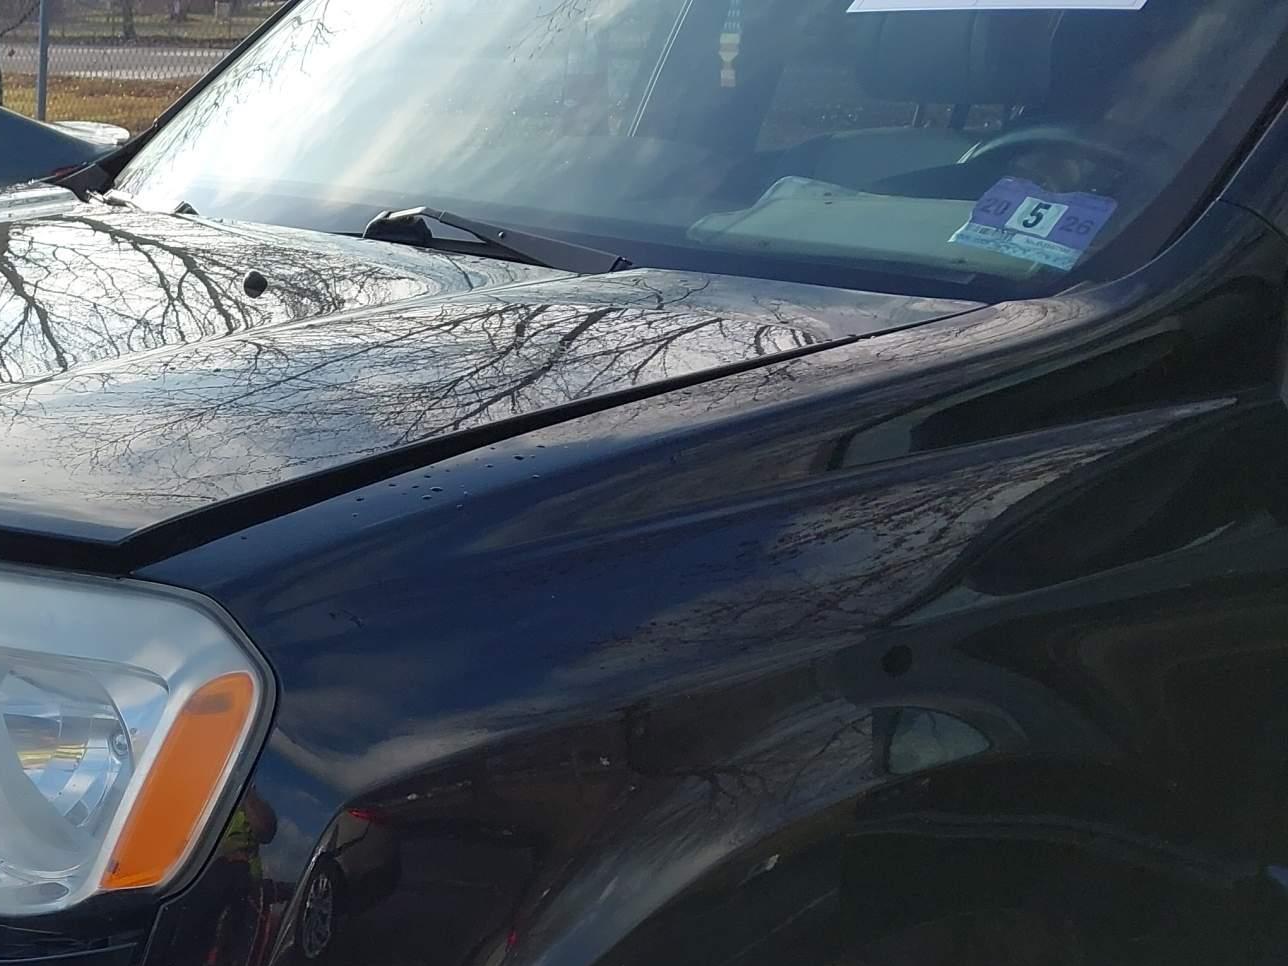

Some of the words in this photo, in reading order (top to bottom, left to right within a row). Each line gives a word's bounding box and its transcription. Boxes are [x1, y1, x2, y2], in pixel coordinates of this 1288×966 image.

[979, 199, 1010, 216] 20
[1022, 202, 1052, 229] 5
[1059, 215, 1095, 236] 26
